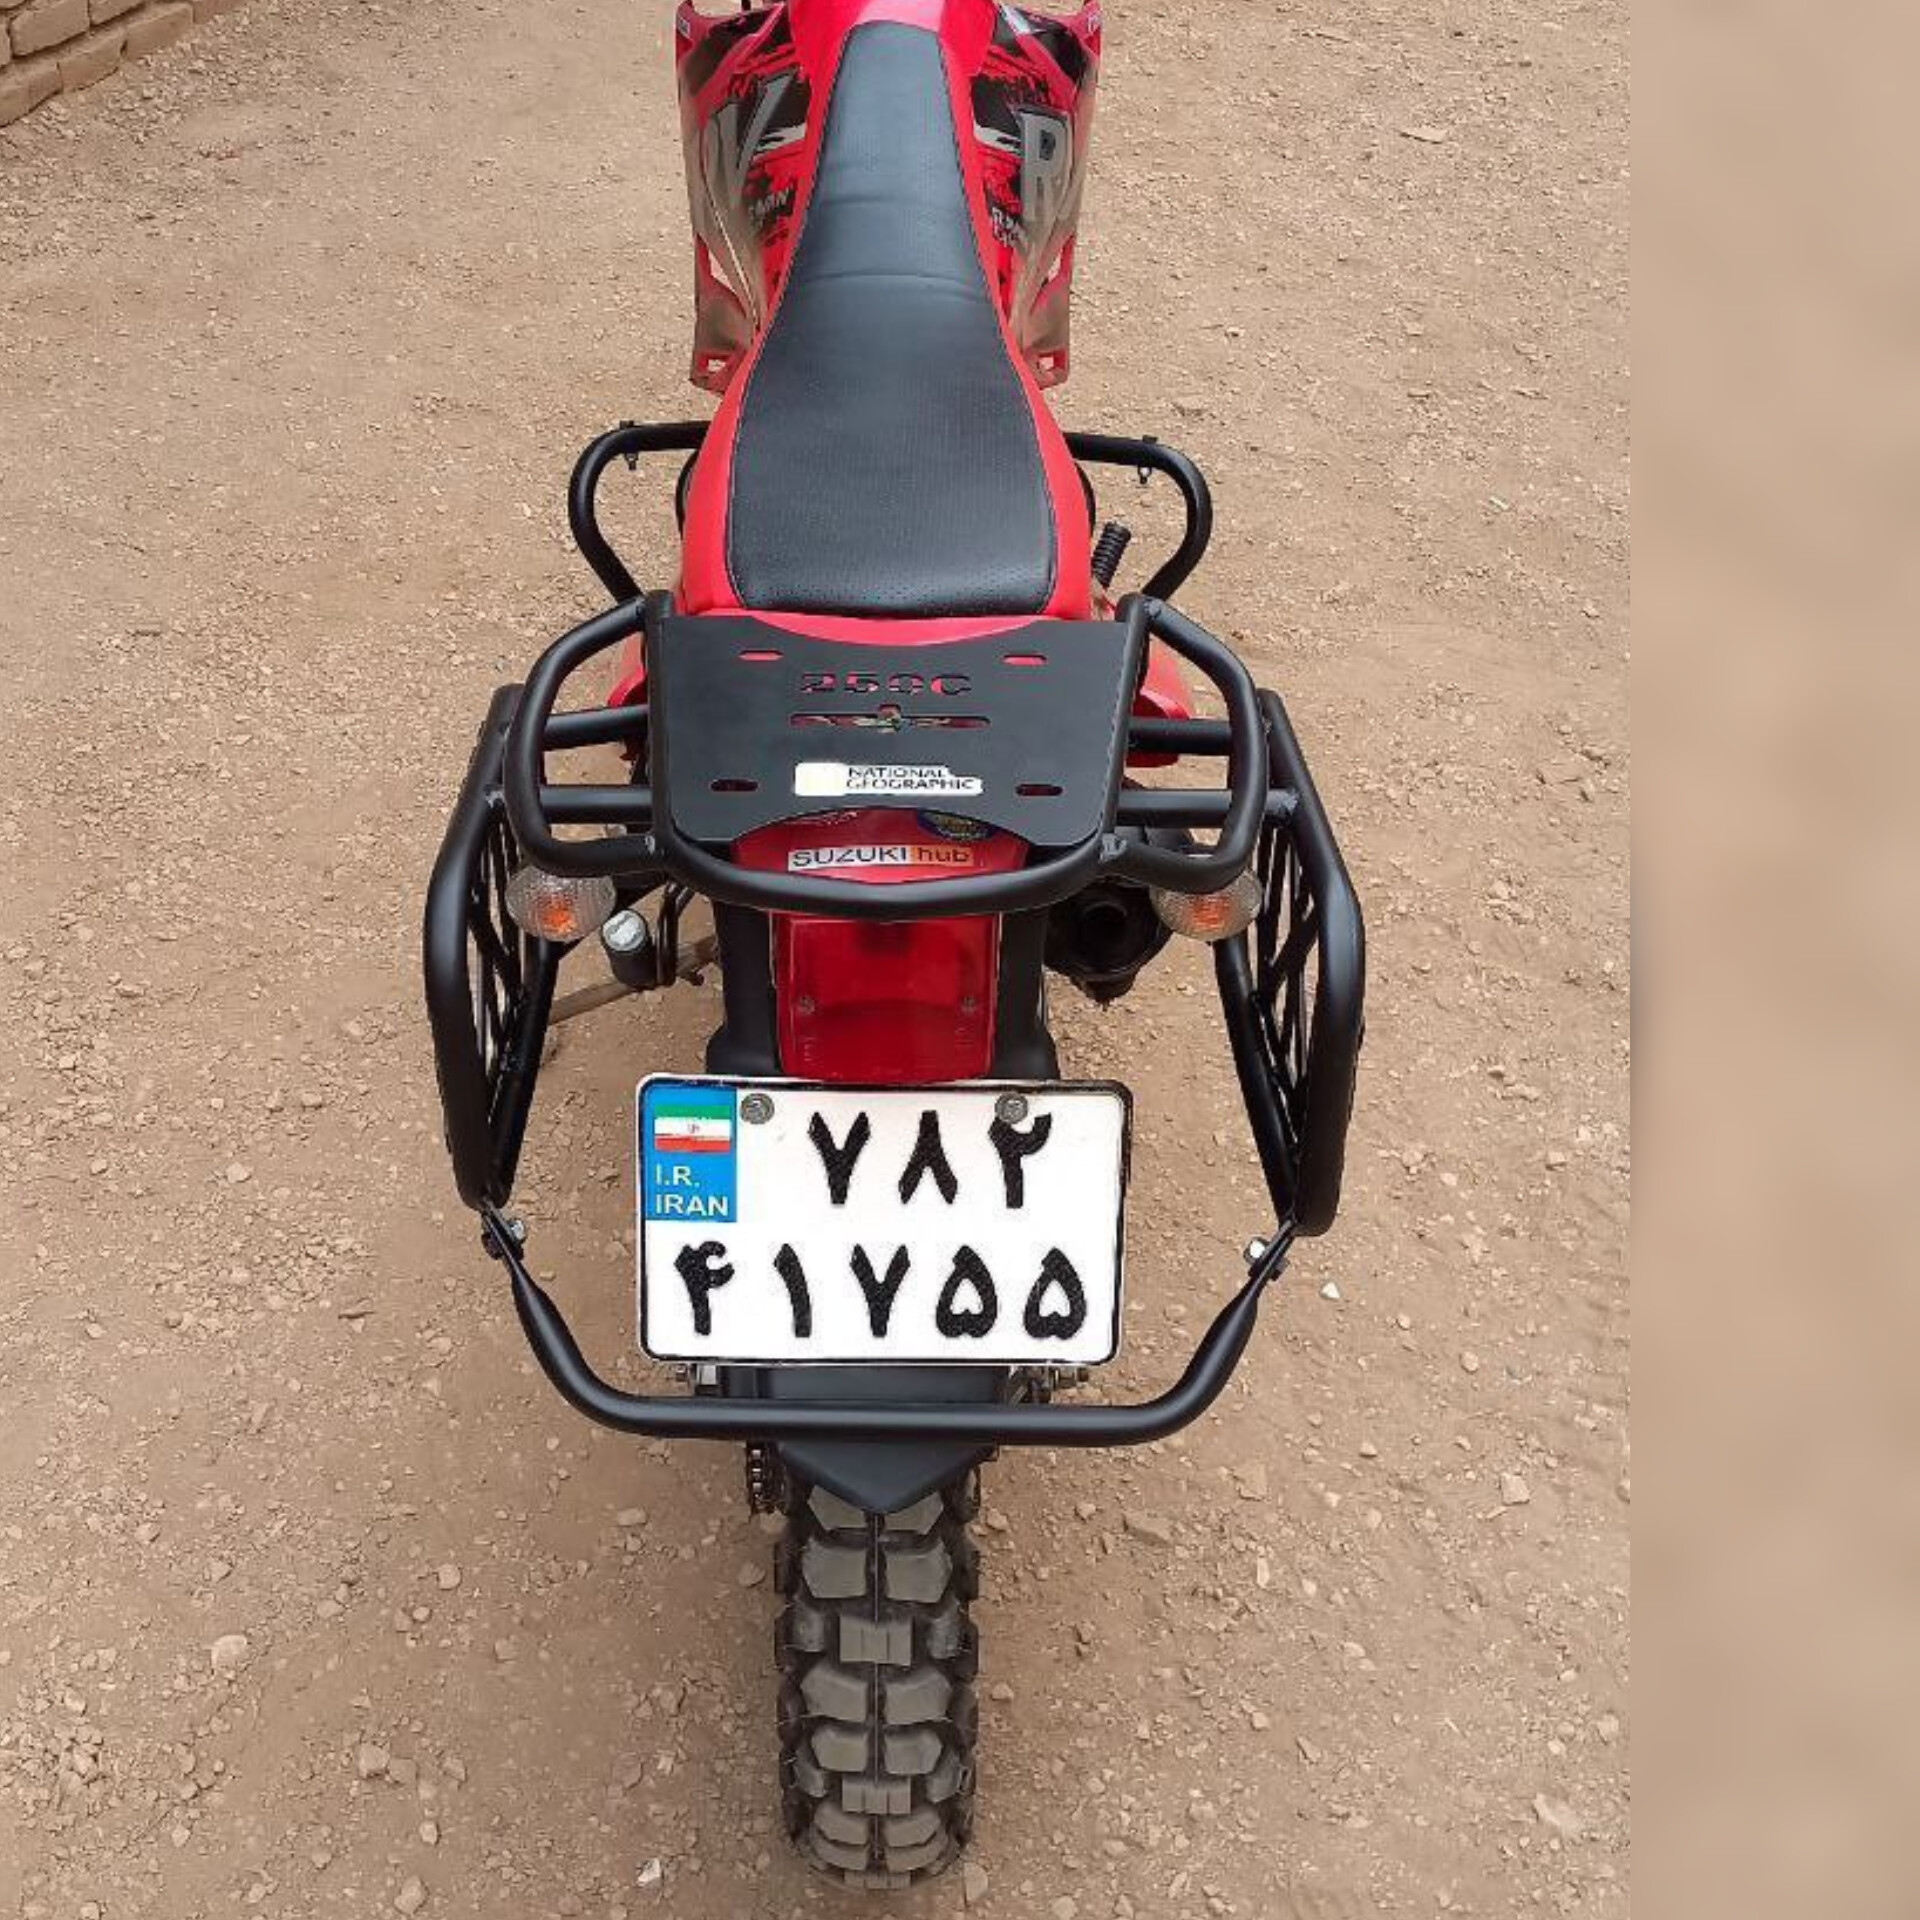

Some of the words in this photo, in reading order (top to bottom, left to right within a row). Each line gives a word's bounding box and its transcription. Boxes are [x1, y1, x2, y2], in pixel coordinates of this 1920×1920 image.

[848, 767, 946, 778] NATIONAL
[846, 778, 975, 790] GEOGRAPHIC
[792, 846, 907, 867] SUZUKI
[918, 846, 969, 863] hub
[655, 1165, 699, 1186] I.R.
[655, 1194, 729, 1217] IRAN
[674, 1241, 1087, 1341] ۴۱۷۵۵
